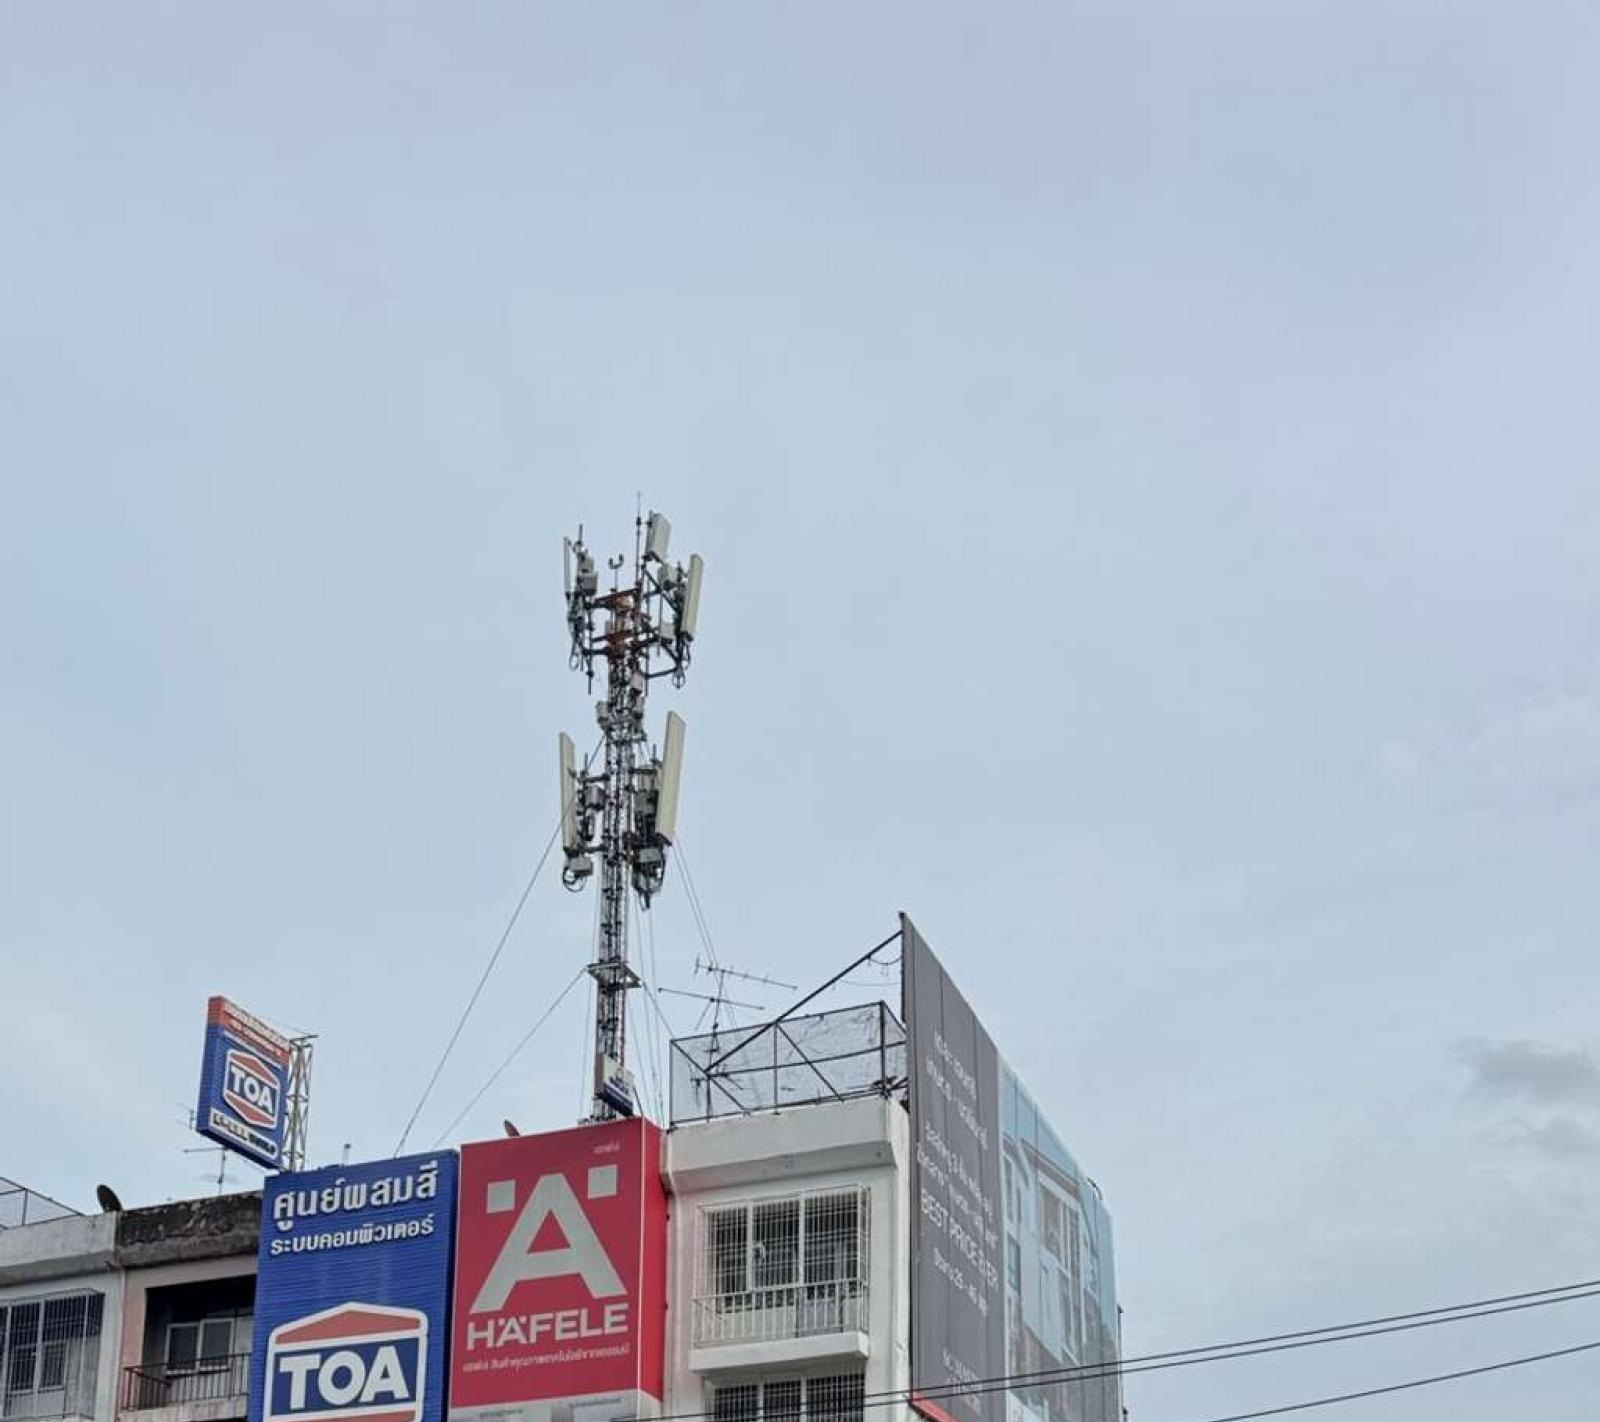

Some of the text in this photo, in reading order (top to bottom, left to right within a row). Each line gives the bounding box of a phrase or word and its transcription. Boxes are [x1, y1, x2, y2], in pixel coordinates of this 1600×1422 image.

[229, 1065, 274, 1114] TOA
[272, 1159, 439, 1231] ศูนย์ผสมสี
[269, 1212, 435, 1256] ระบบคอมพิวเตอร์
[466, 1302, 630, 1351] HÄFELE
[278, 1345, 412, 1411] TOA
